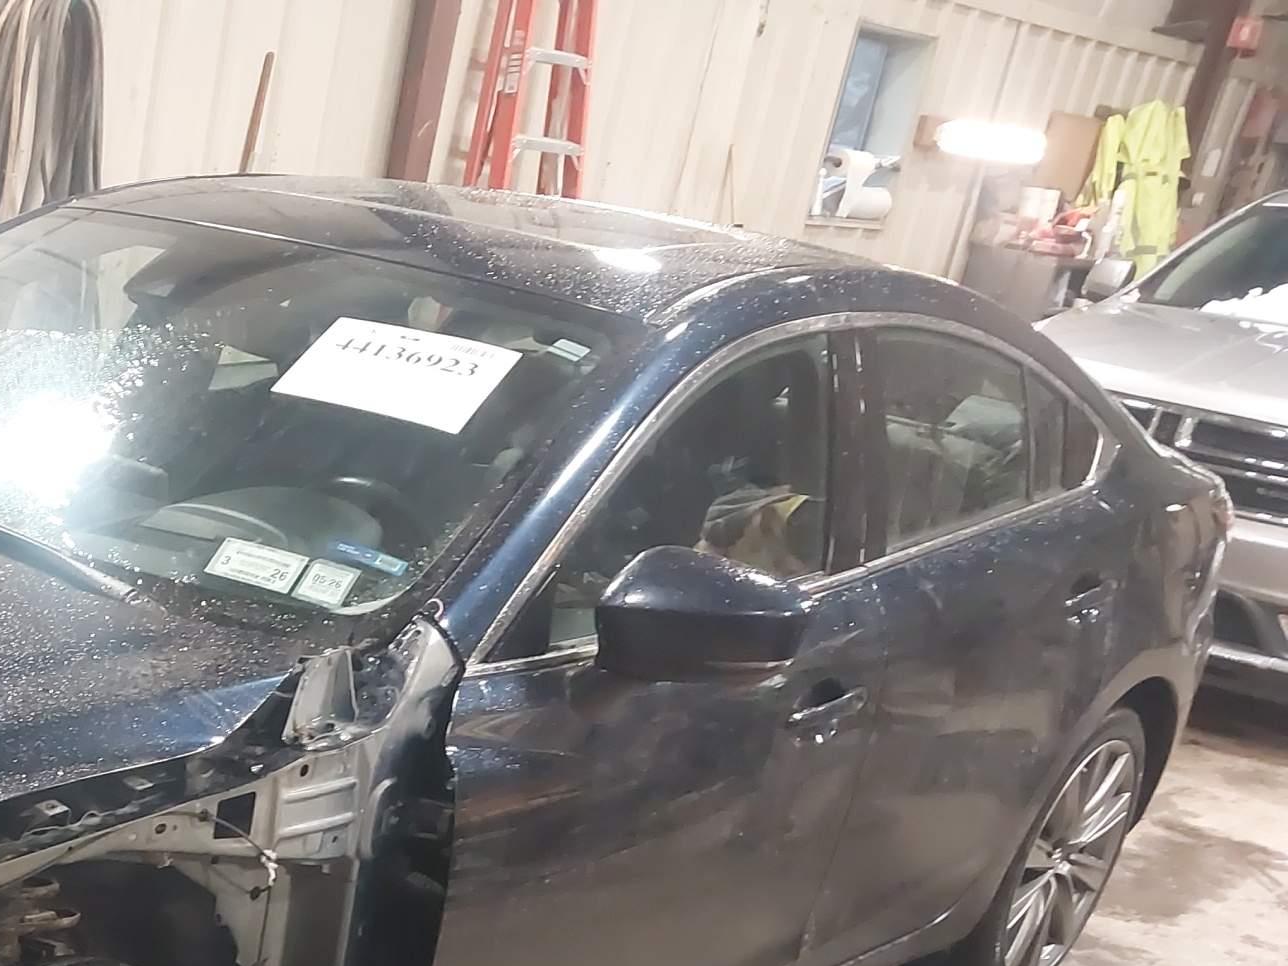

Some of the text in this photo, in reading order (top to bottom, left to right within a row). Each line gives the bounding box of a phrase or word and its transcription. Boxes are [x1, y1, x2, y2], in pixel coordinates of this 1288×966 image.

[335, 337, 480, 377] 44136923
[220, 555, 232, 565] 3
[269, 568, 289, 582] 26
